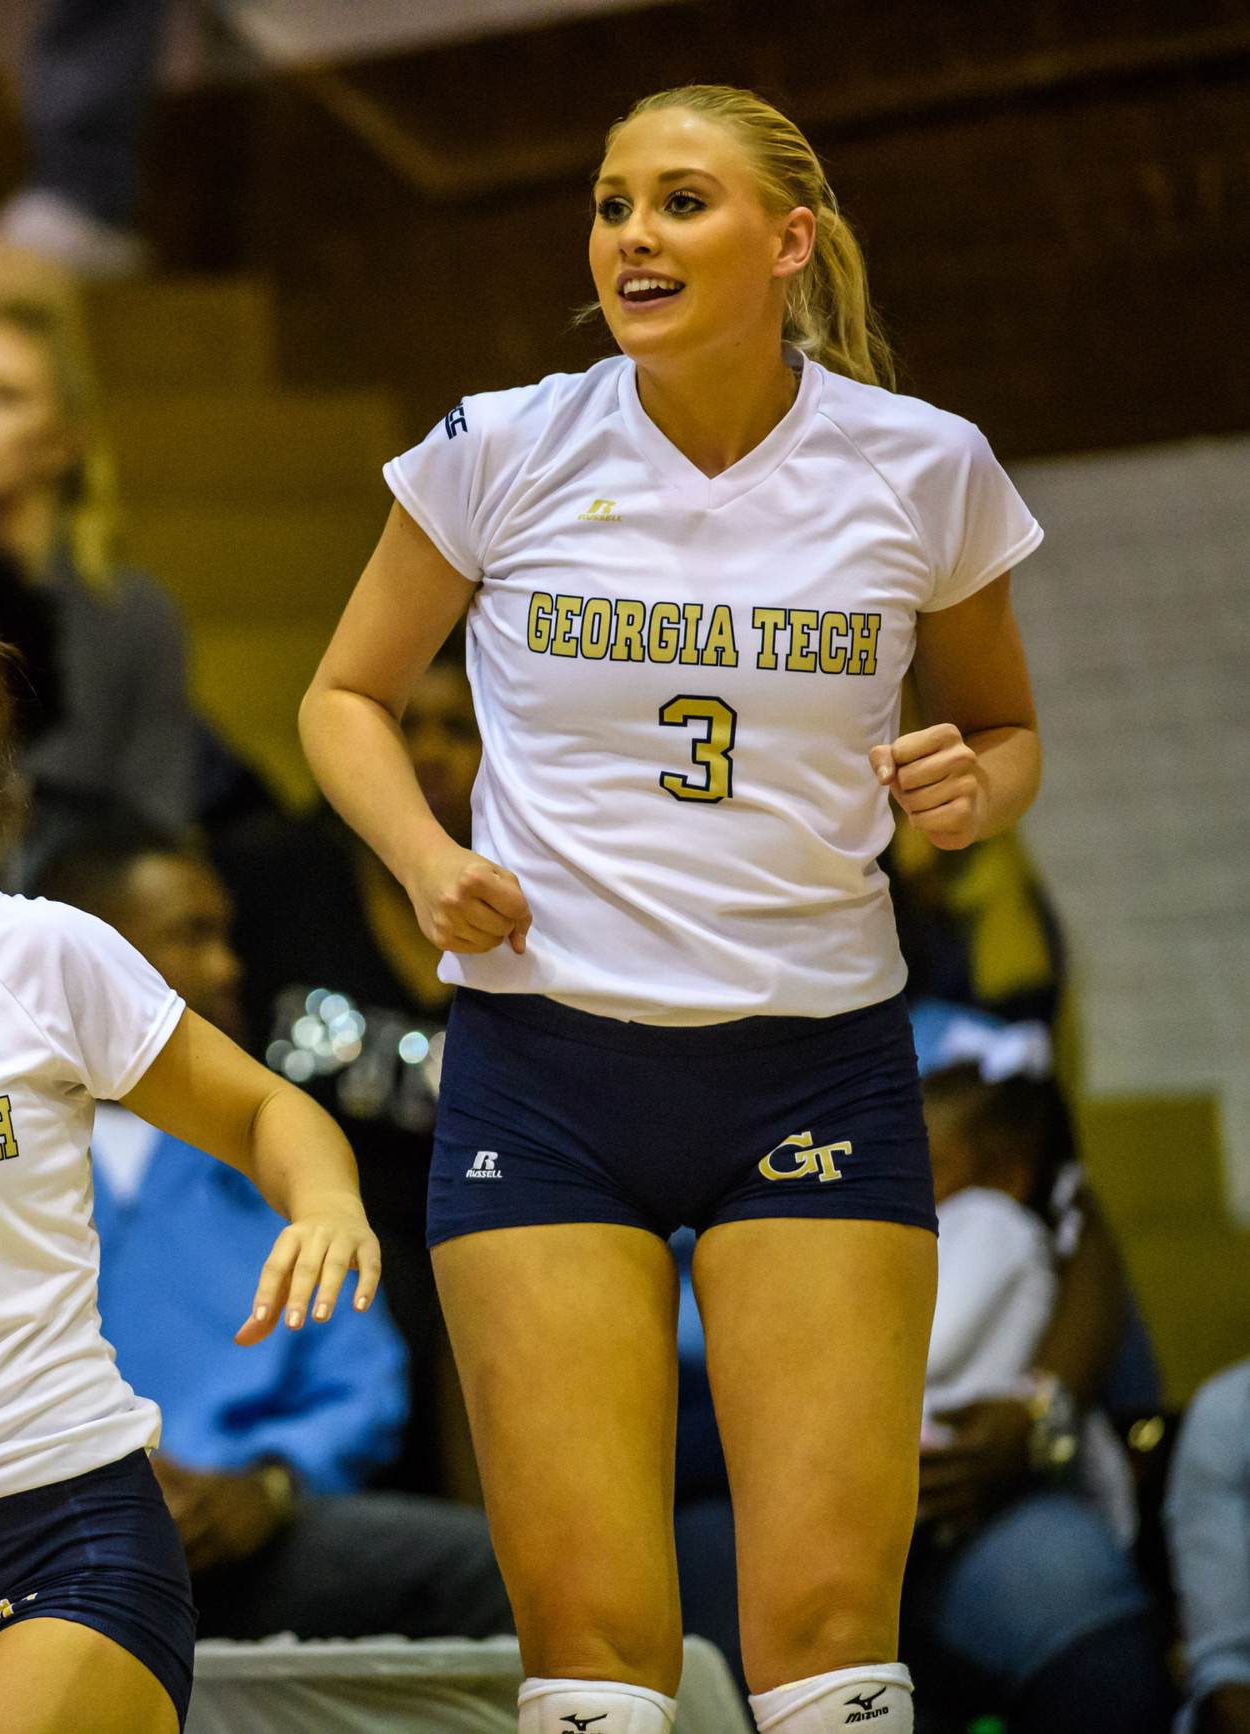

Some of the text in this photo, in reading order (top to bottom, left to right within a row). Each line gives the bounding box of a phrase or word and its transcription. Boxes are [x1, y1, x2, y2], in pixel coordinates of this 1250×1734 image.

[445, 402, 468, 440] CC
[527, 591, 881, 676] GEORGIA TECH
[658, 694, 737, 804] 3
[465, 1168, 503, 1178] RUSSELL
[758, 1130, 852, 1182] GT
